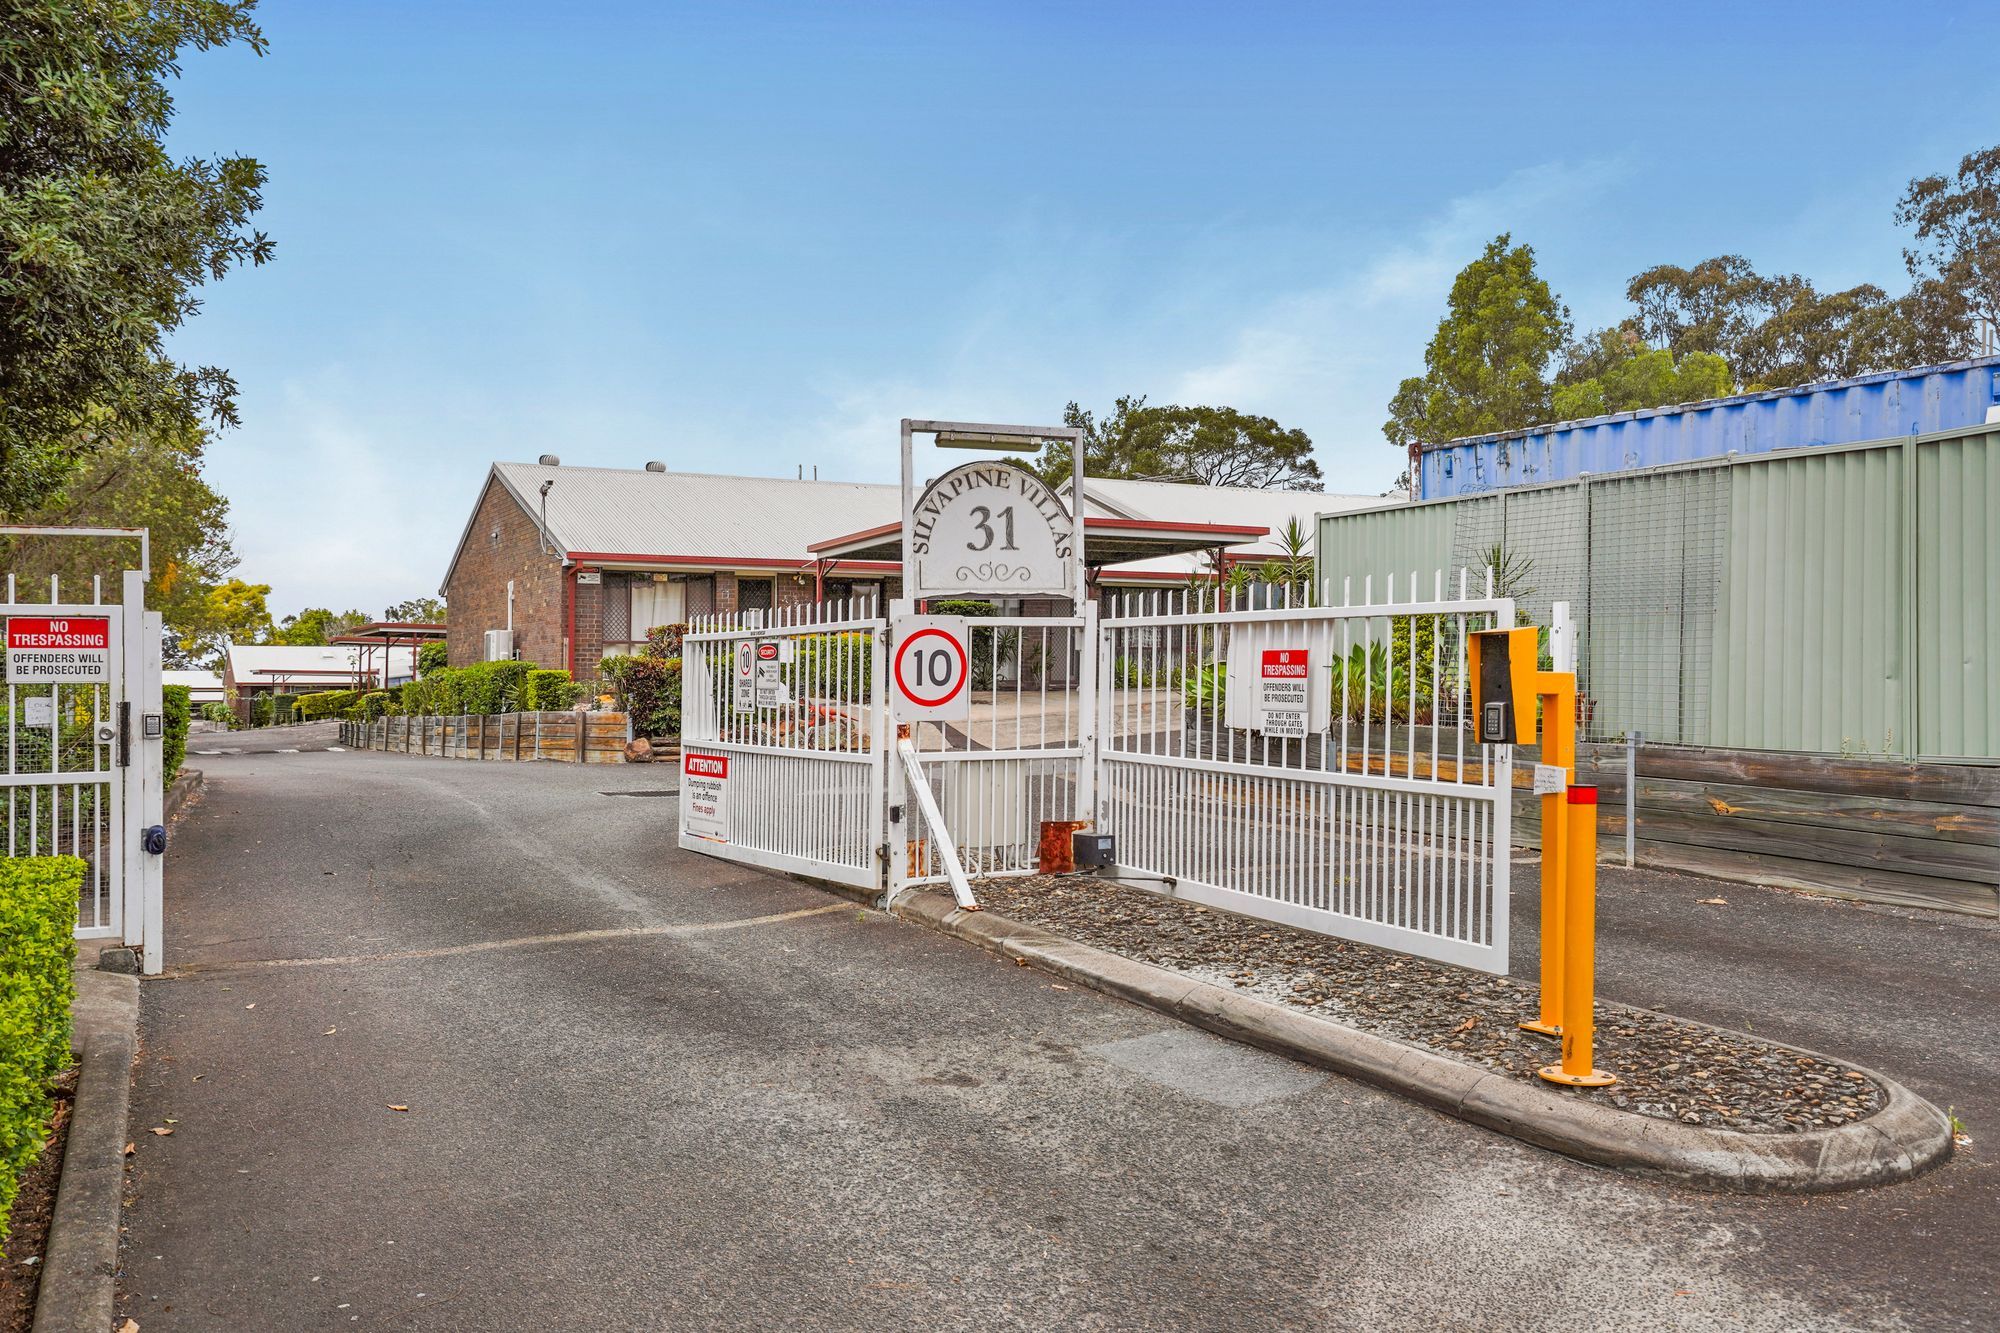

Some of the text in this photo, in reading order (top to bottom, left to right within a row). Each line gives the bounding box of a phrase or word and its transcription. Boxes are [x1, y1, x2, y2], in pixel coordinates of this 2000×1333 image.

[913, 469, 1074, 559] SILVAPINE VILLAS
[966, 506, 1020, 551] 31
[50, 621, 69, 633] NO
[13, 634, 104, 646] TRESPASSING
[13, 654, 104, 663] OFFENDERS WILL
[742, 651, 750, 668] 10
[1280, 652, 1290, 663] NO
[16, 665, 101, 675] BE PROSECUTED
[914, 649, 952, 687] 10
[1263, 665, 1305, 676] TRESPASSING
[1263, 683, 1305, 692] OFFENDERS WILL
[1264, 694, 1304, 703] BE PROSECUTED
[1264, 726, 1279, 734] WHILE
[1286, 727, 1304, 735] MOTION
[688, 757, 723, 774] ATTENTION
[688, 777, 722, 791] Dumping rubbish
[702, 791, 717, 802] offence
[692, 802, 715, 817] Fines apply
